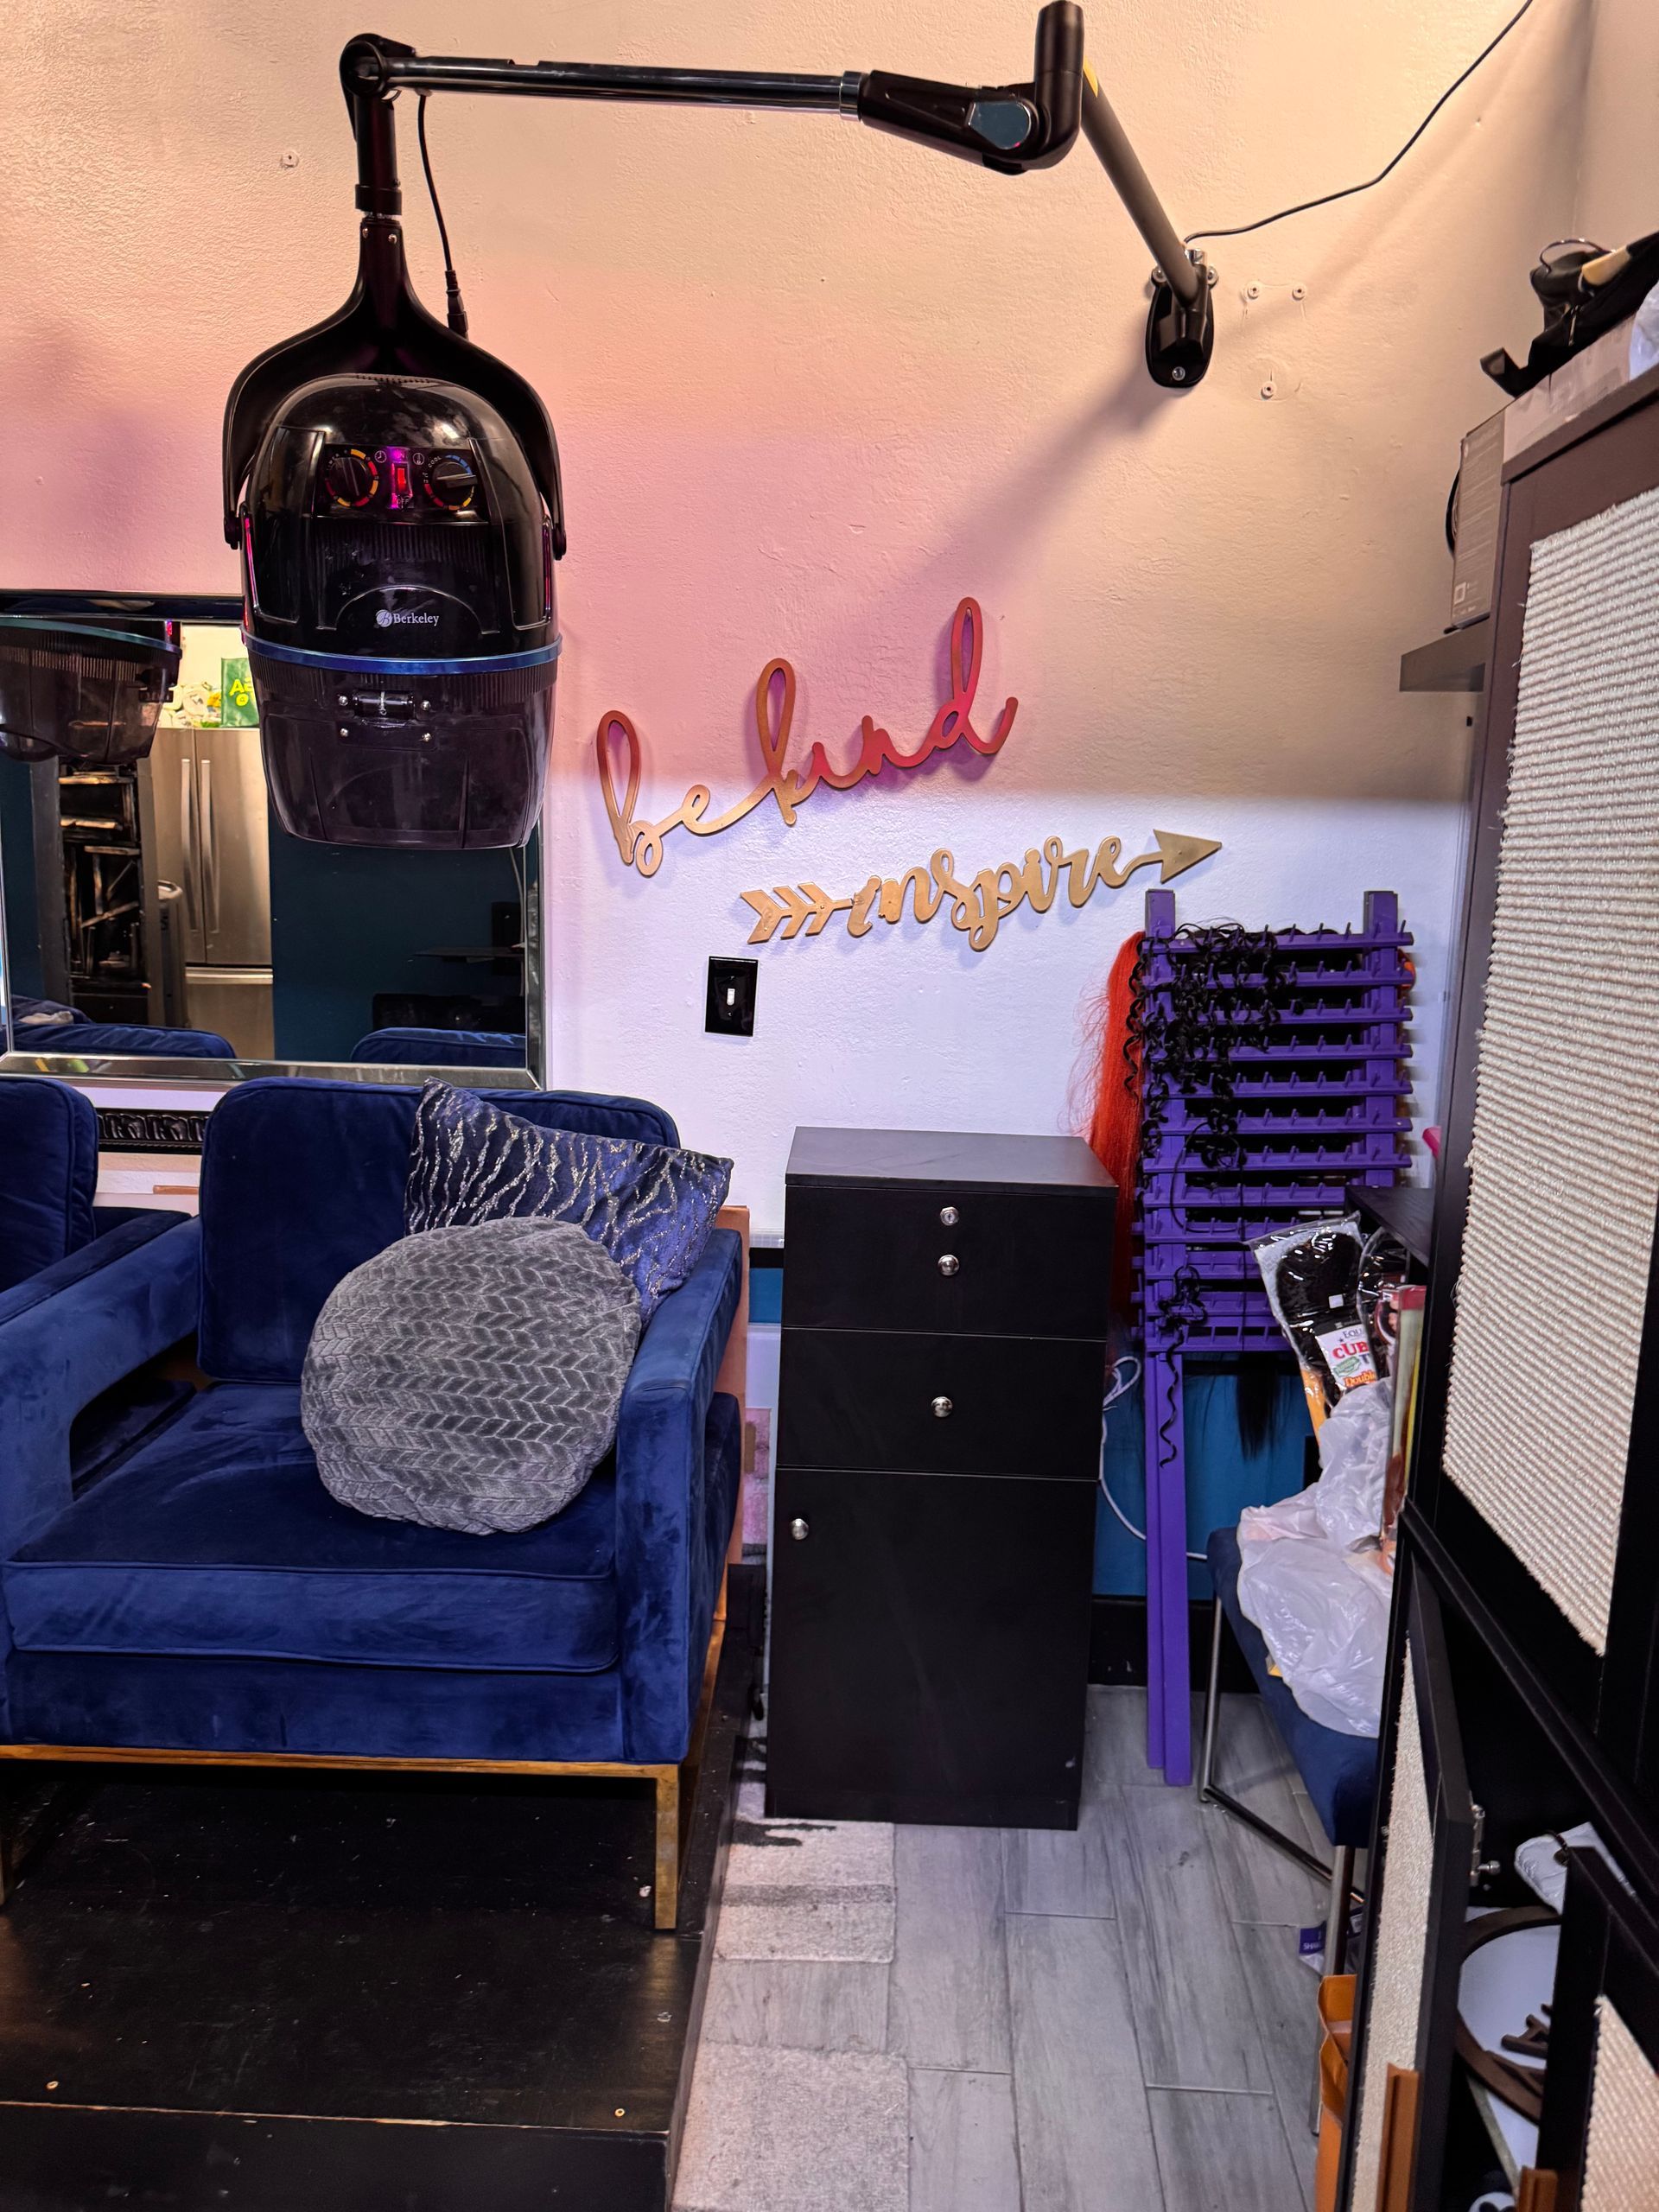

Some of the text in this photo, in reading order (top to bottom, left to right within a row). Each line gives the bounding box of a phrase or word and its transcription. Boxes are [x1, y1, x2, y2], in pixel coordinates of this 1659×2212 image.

[427, 455, 442, 468] COOL
[393, 612, 440, 626] Berkeley
[596, 596, 1019, 876] be kind
[846, 835, 1125, 951] inspire
